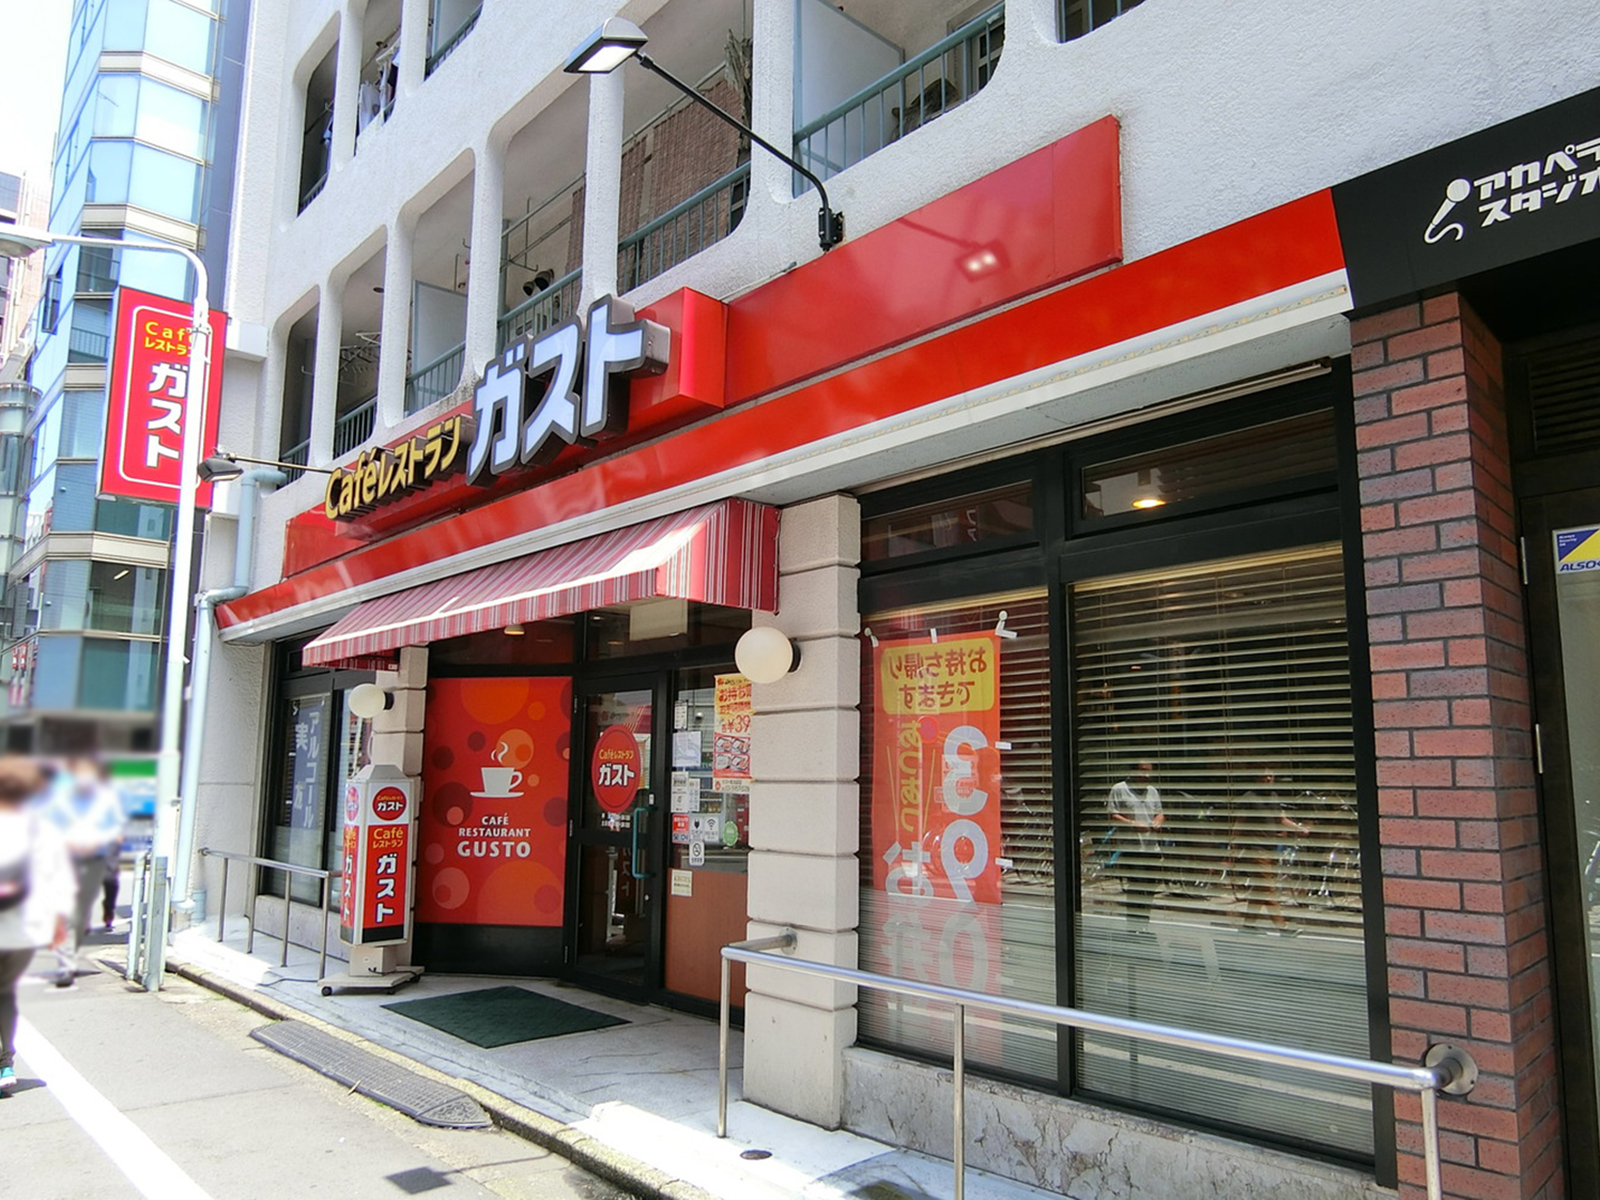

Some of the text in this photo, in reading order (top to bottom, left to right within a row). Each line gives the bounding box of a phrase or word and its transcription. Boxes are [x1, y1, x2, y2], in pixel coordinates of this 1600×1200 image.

[1474, 137, 1600, 200] アカペラ
[1478, 167, 1600, 227] スタジオ
[467, 296, 646, 484] ガスト
[147, 362, 188, 468] ガスト
[1560, 561, 1600, 572] ALSO
[303, 712, 320, 828] アルコール
[598, 762, 635, 786] ガスト
[377, 801, 404, 812] ガスト
[481, 813, 509, 825] CAFÉ
[373, 827, 404, 840] Café
[458, 828, 531, 838] RESTAURANT
[372, 839, 404, 849] レストラン
[457, 841, 532, 858] GUSTO
[376, 852, 398, 923] ガスト
